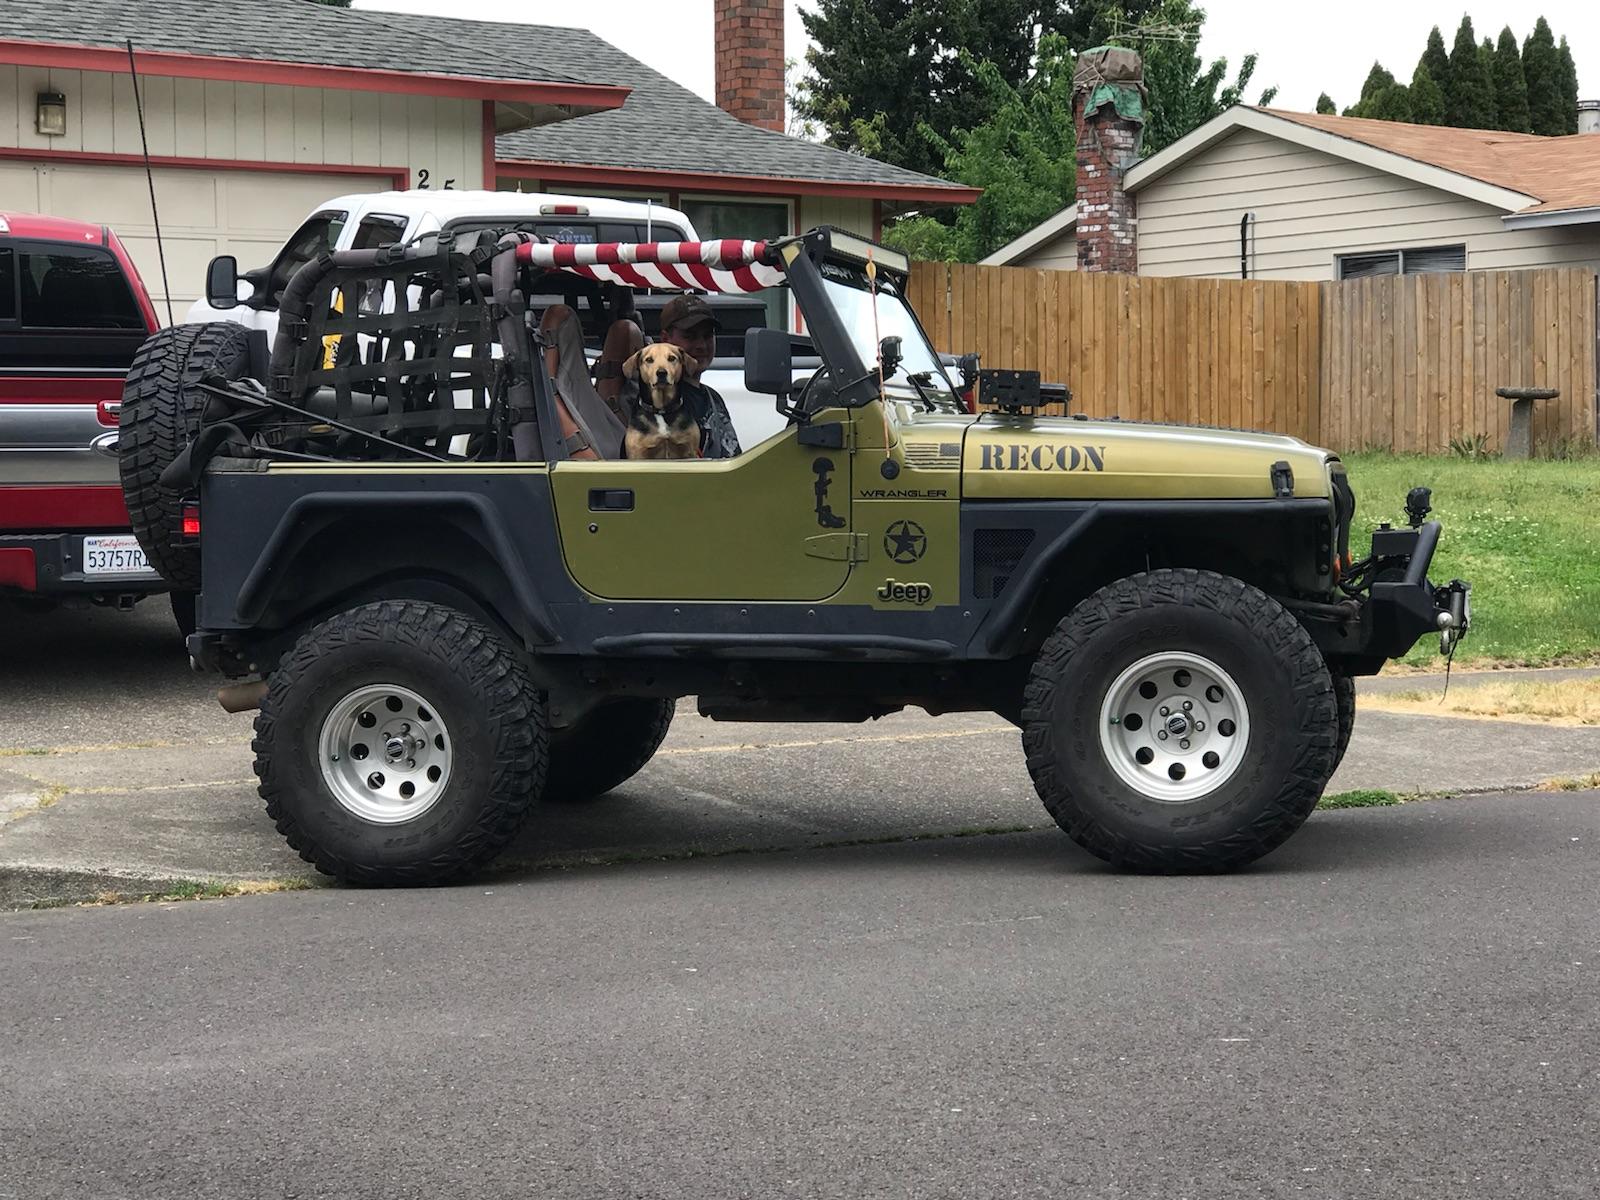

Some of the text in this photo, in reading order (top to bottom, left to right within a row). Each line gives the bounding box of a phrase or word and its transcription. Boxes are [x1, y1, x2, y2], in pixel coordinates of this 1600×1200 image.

[417, 168, 429, 189] 2
[980, 444, 1107, 472] RECON
[860, 489, 947, 498] WRANGLER
[877, 577, 933, 606] Jeep
